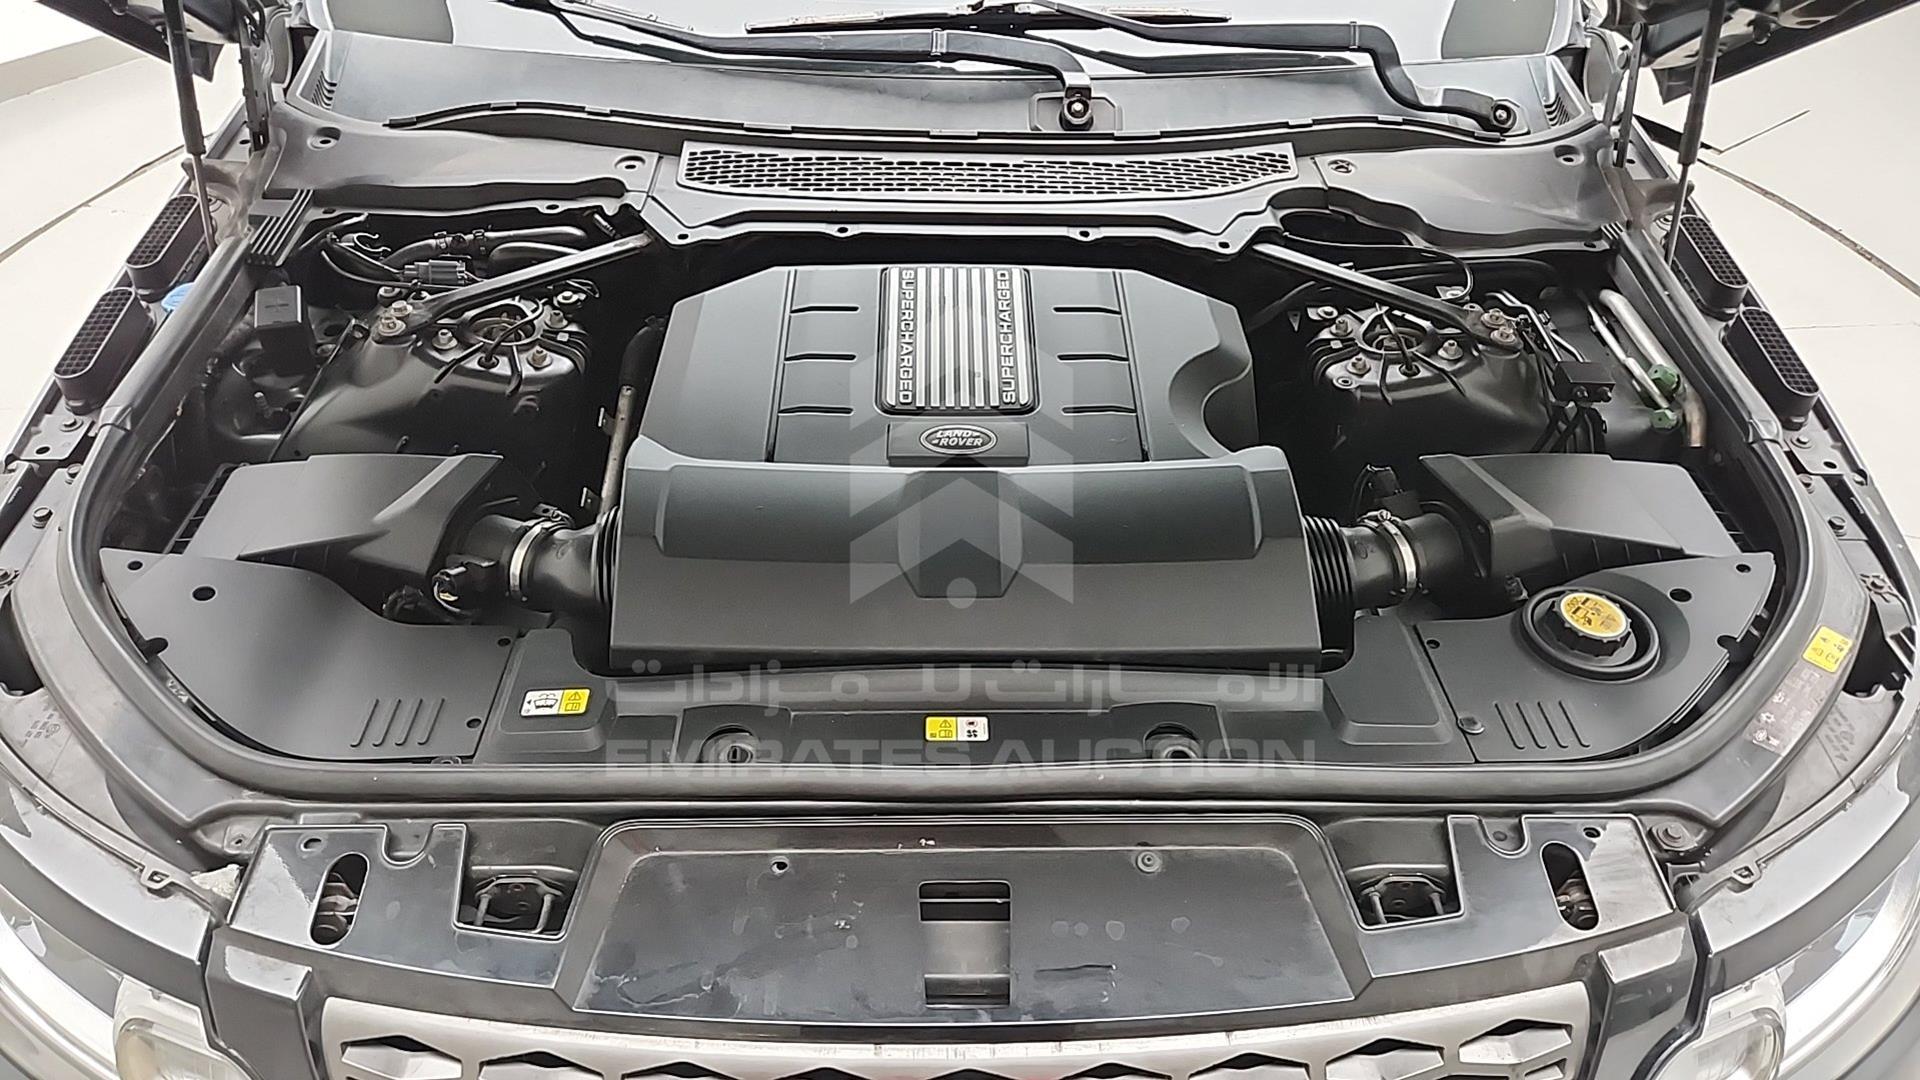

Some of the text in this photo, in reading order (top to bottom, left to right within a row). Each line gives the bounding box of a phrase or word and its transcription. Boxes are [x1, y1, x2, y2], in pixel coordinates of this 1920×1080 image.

[900, 269, 915, 405] SUPERCHARGED
[996, 269, 1017, 405] SUPERCHARGED
[936, 429, 973, 438] LAND
[939, 437, 983, 447] ROVER
